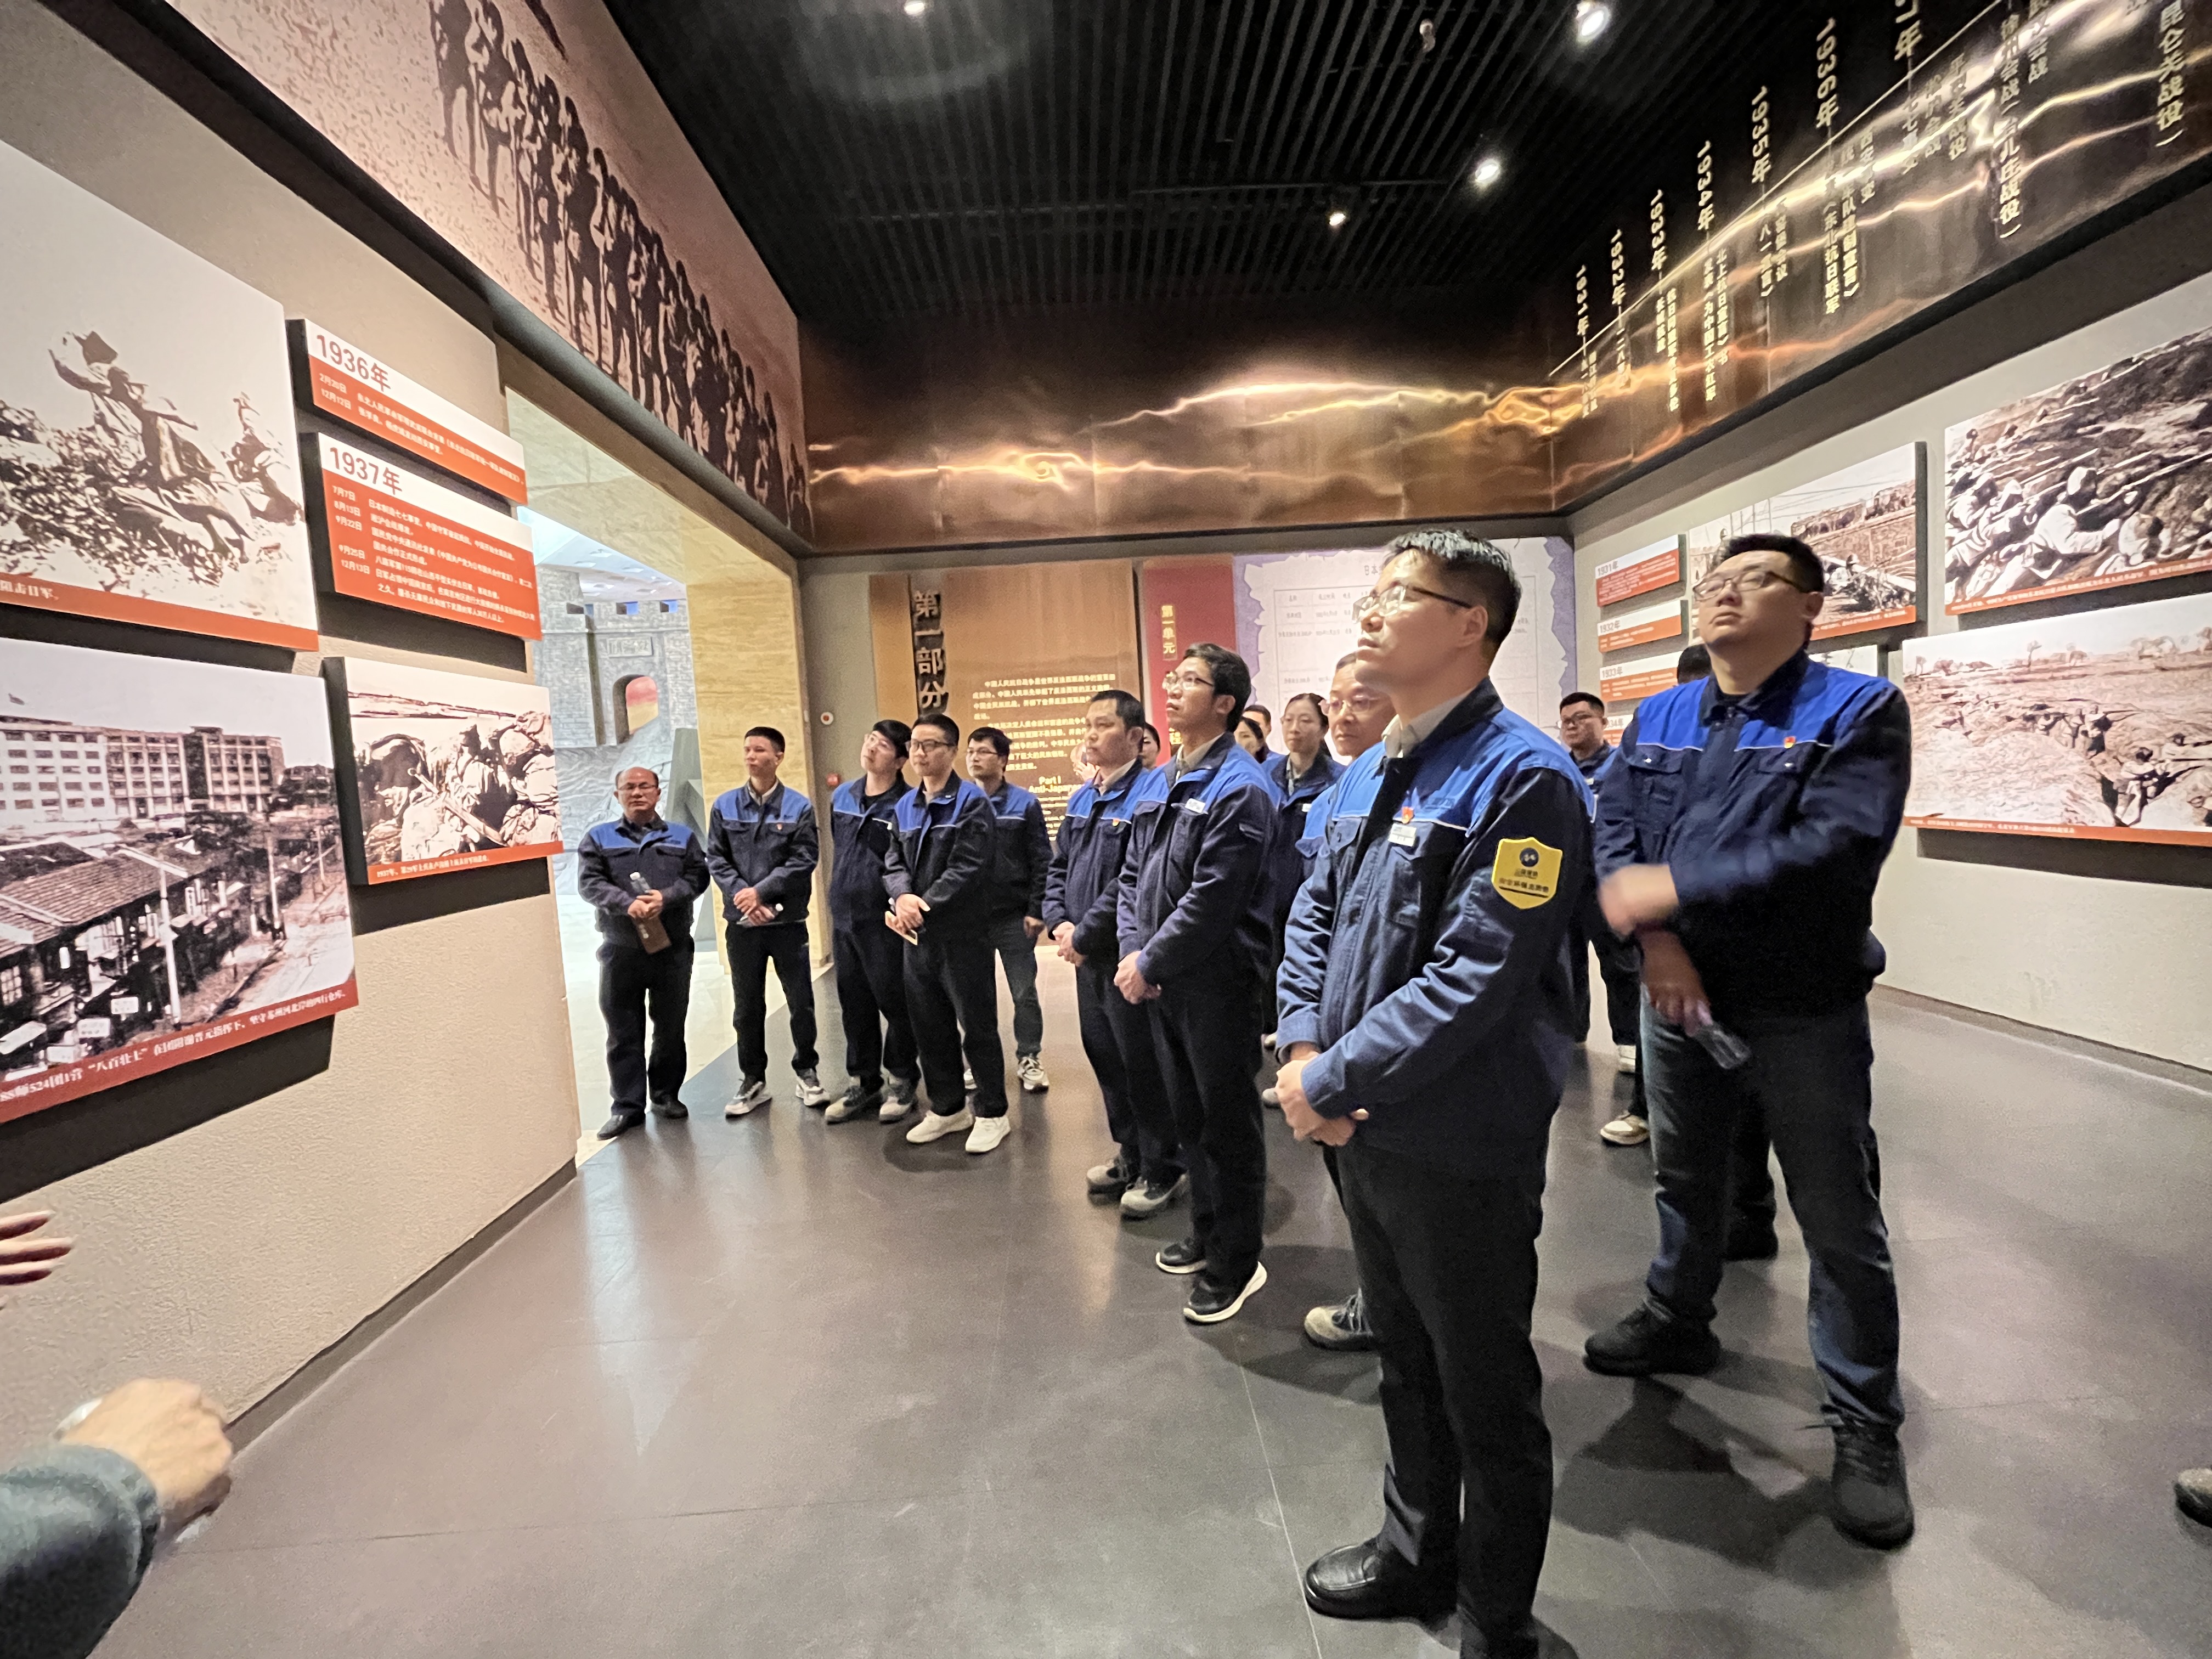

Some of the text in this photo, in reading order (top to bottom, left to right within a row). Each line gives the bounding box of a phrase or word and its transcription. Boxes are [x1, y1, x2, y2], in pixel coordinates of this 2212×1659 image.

[1816, 18, 1839, 129] 1936年
[1752, 86, 1771, 183] 1935年
[1697, 140, 1714, 230] 1934年
[1650, 189, 1667, 270] 1933年
[1611, 229, 1626, 305] 1932年
[1576, 264, 1590, 336] 1931年
[317, 335, 391, 392] 1936年
[330, 447, 403, 495] 1937年
[332, 485, 356, 501] 7月7日
[335, 515, 362, 532] 9月22日
[915, 591, 949, 708] 第一部分
[1161, 605, 1175, 654] 第一单元
[1607, 718, 1624, 729] 34年
[1039, 776, 1057, 785] Part
